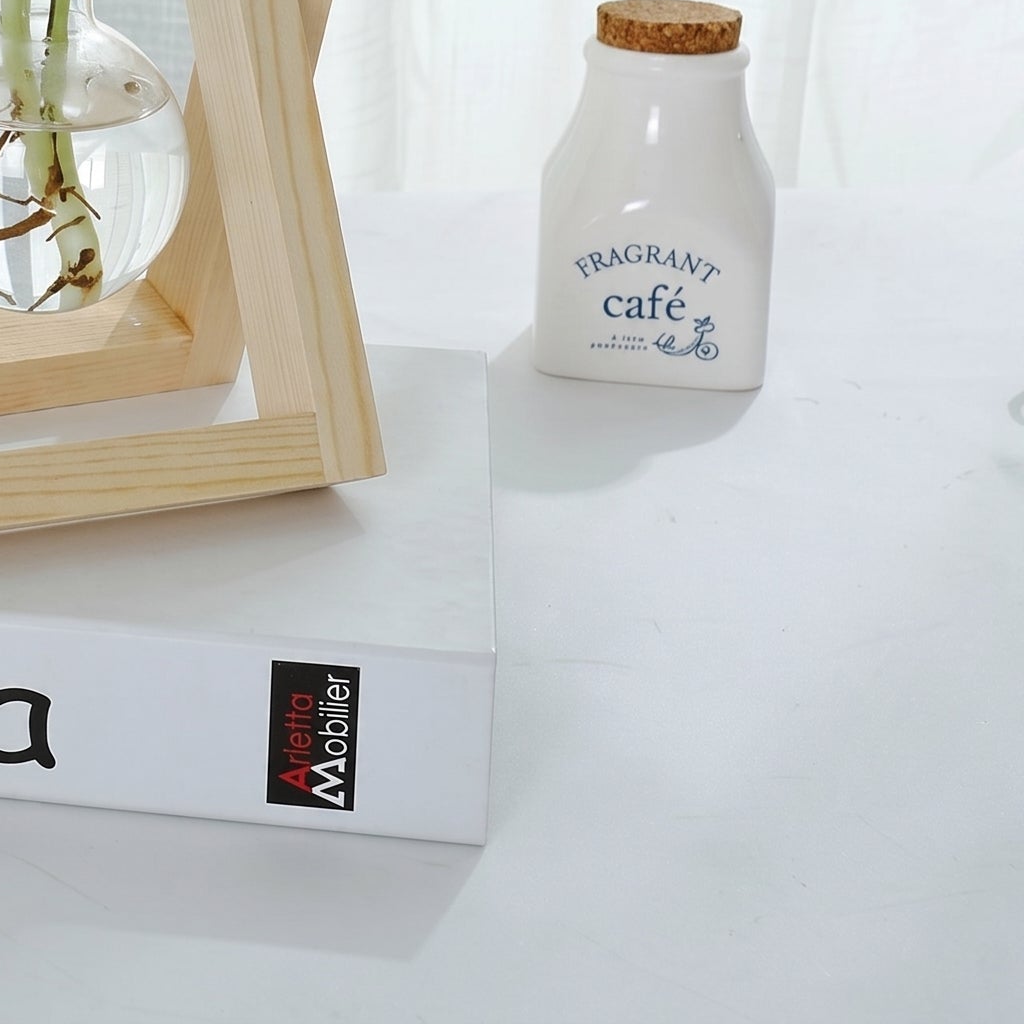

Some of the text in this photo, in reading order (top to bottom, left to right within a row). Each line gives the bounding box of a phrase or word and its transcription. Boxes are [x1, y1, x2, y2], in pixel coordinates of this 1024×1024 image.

[574, 243, 721, 284] FRAGRANT
[603, 284, 686, 321] café
[278, 693, 313, 793] Arletta
[311, 674, 350, 808] Mobilier
